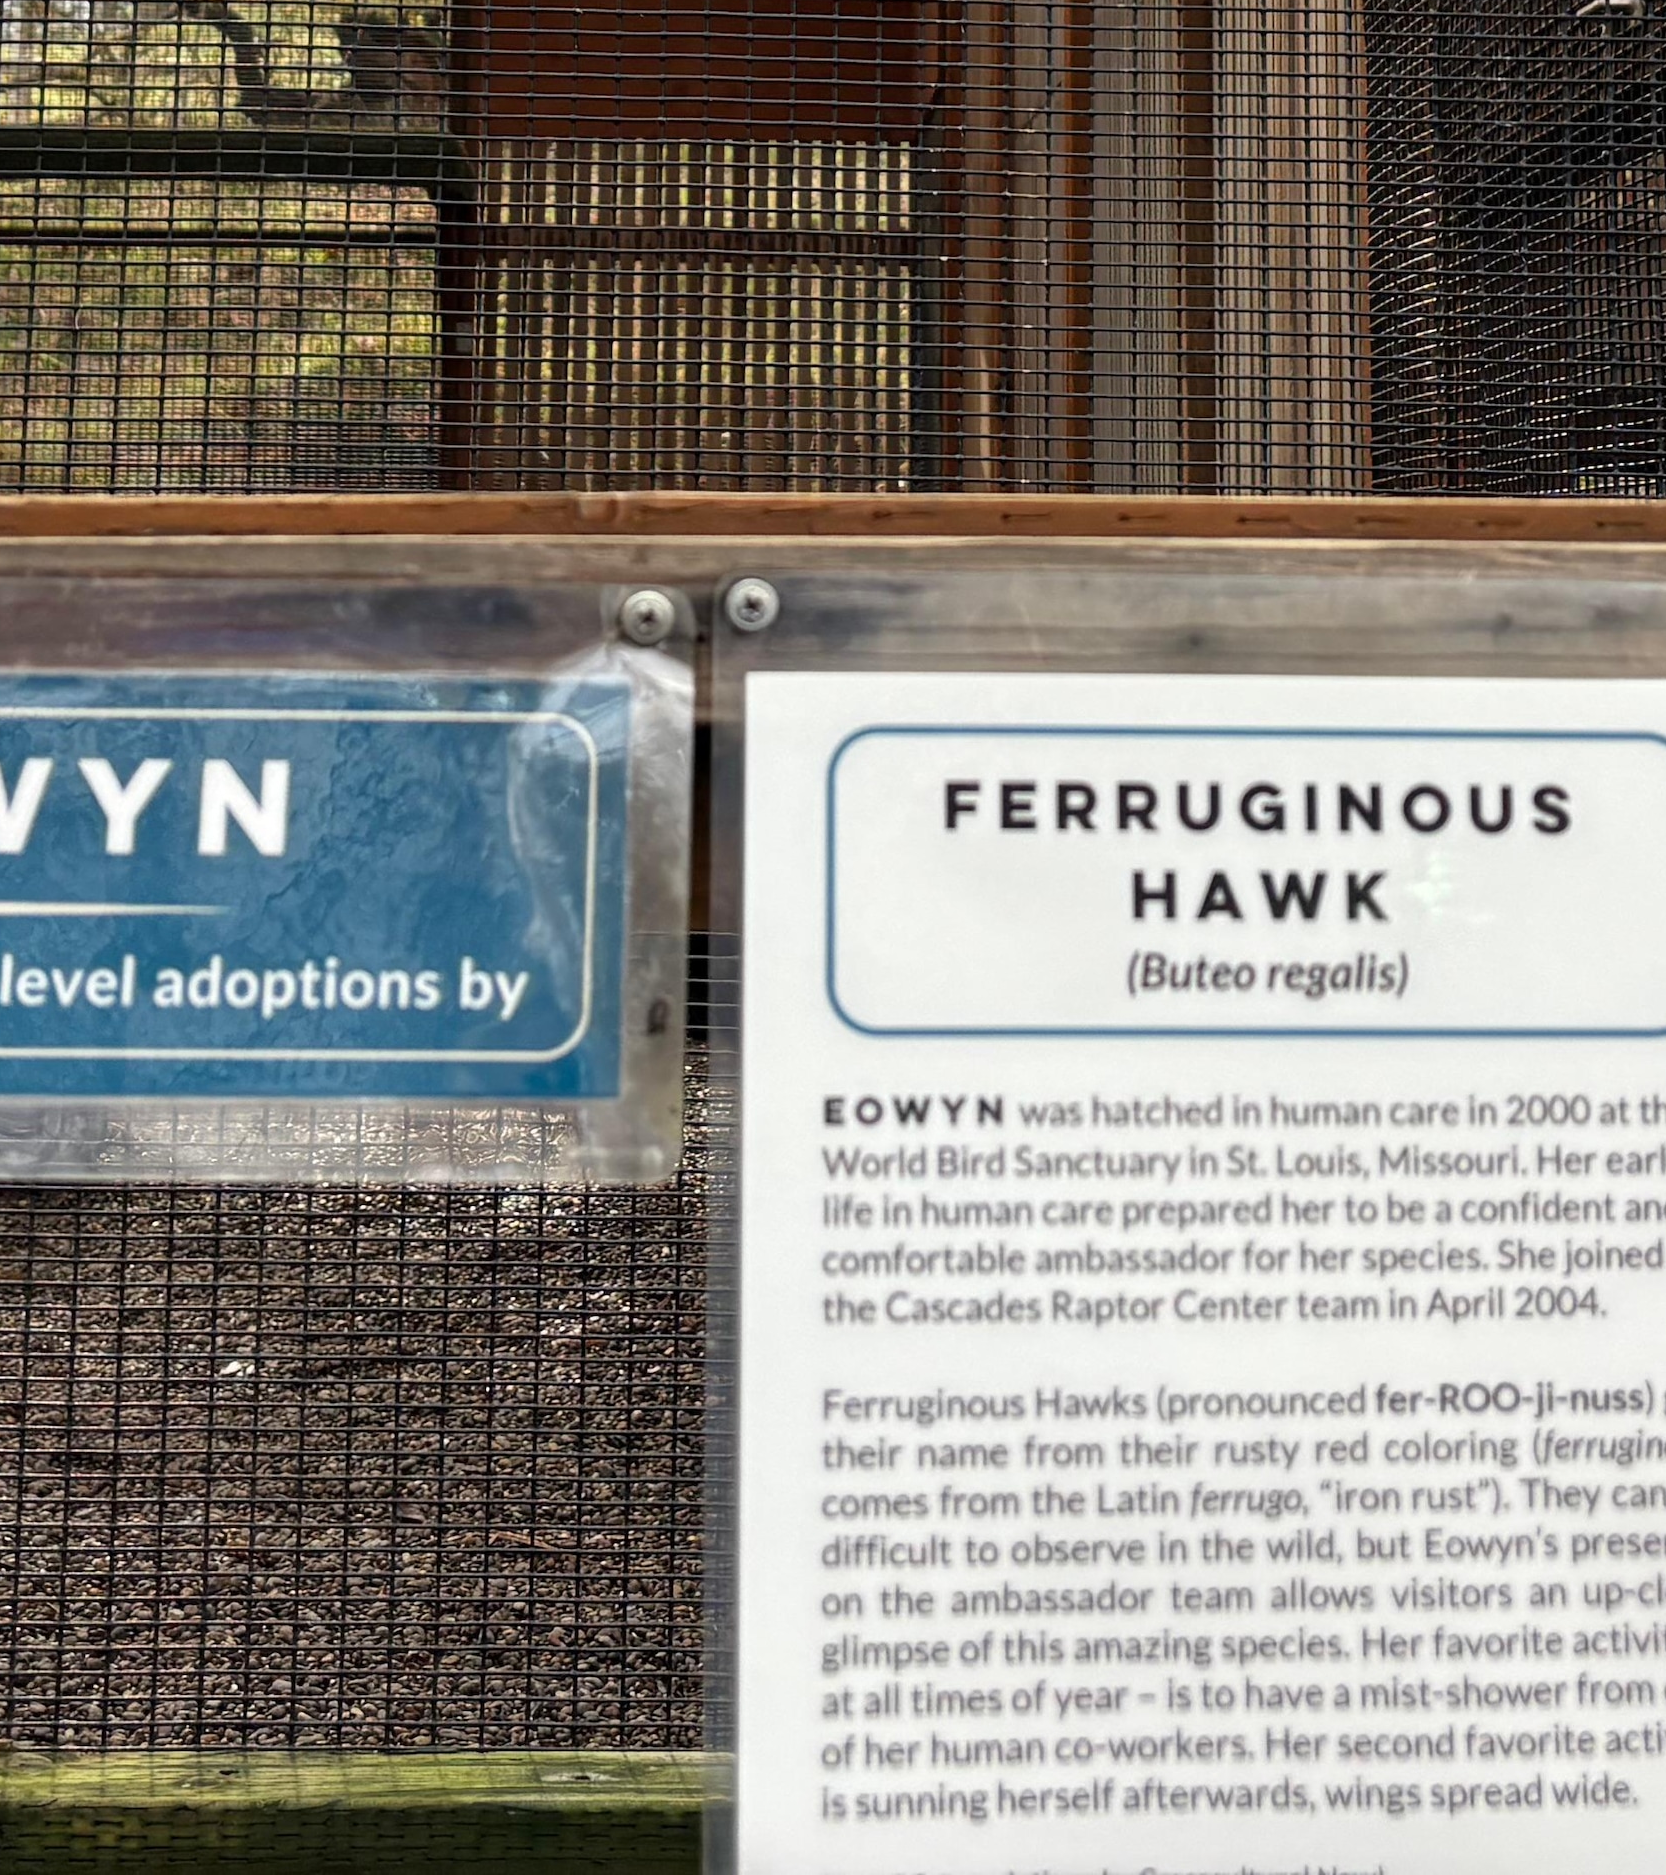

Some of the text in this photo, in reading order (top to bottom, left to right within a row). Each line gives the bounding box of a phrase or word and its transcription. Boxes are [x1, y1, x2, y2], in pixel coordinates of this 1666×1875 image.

[945, 780, 1571, 836] FERRUGINOUS
[1132, 869, 1387, 921] HAWK
[0, 952, 136, 1008] level
[153, 954, 442, 1020] adoptions
[459, 956, 529, 1021] by
[1127, 950, 1409, 1001] (Buteo regalis)
[823, 1095, 1003, 1128] EOWYN
[1019, 1103, 1084, 1126] was
[1093, 1096, 1223, 1127] hatched
[1234, 1096, 1261, 1126] in
[1271, 1096, 1384, 1126] human
[1391, 1103, 1459, 1126] care
[1469, 1095, 1497, 1126] in
[1507, 1094, 1591, 1126] 2000
[1600, 1097, 1629, 1126] at
[822, 1146, 927, 1180] World
[937, 1145, 1006, 1180] Bird
[1015, 1144, 1181, 1184] Sanctuary
[1189, 1145, 1219, 1178] in
[1227, 1144, 1267, 1178] St.
[1276, 1145, 1370, 1181] Louis,
[1379, 1144, 1527, 1178] Missouri.
[1537, 1144, 1597, 1177] Her
[823, 1194, 873, 1228] life
[883, 1194, 912, 1227] in
[921, 1193, 1034, 1227] human
[1042, 1201, 1114, 1227] care
[1122, 1192, 1272, 1232] prepared
[1281, 1192, 1335, 1225] her
[1344, 1195, 1379, 1225] to
[1387, 1192, 1426, 1225] be
[1434, 1200, 1452, 1225] a
[1460, 1191, 1616, 1225] confident
[821, 1237, 1664, 1279] comfortable ambassador for her species. She joined
[822, 1285, 1607, 1328] the Cascades Raptor Center team in April 2004.
[823, 1387, 1026, 1428] Ferruginous
[1035, 1386, 1148, 1419] Hawks
[1157, 1383, 1367, 1424] (pronounced
[1374, 1379, 1655, 1422] fer-ROO-ji-nuss)
[821, 1493, 929, 1520] comes
[939, 1484, 1021, 1519] from
[1031, 1483, 1086, 1518] the
[1097, 1482, 1180, 1517] Latin
[1190, 1481, 1309, 1522] ferrugo,
[1520, 1477, 1601, 1517] They
[823, 1773, 1638, 1822] is sunning herself afterwards, wings spread wide.
